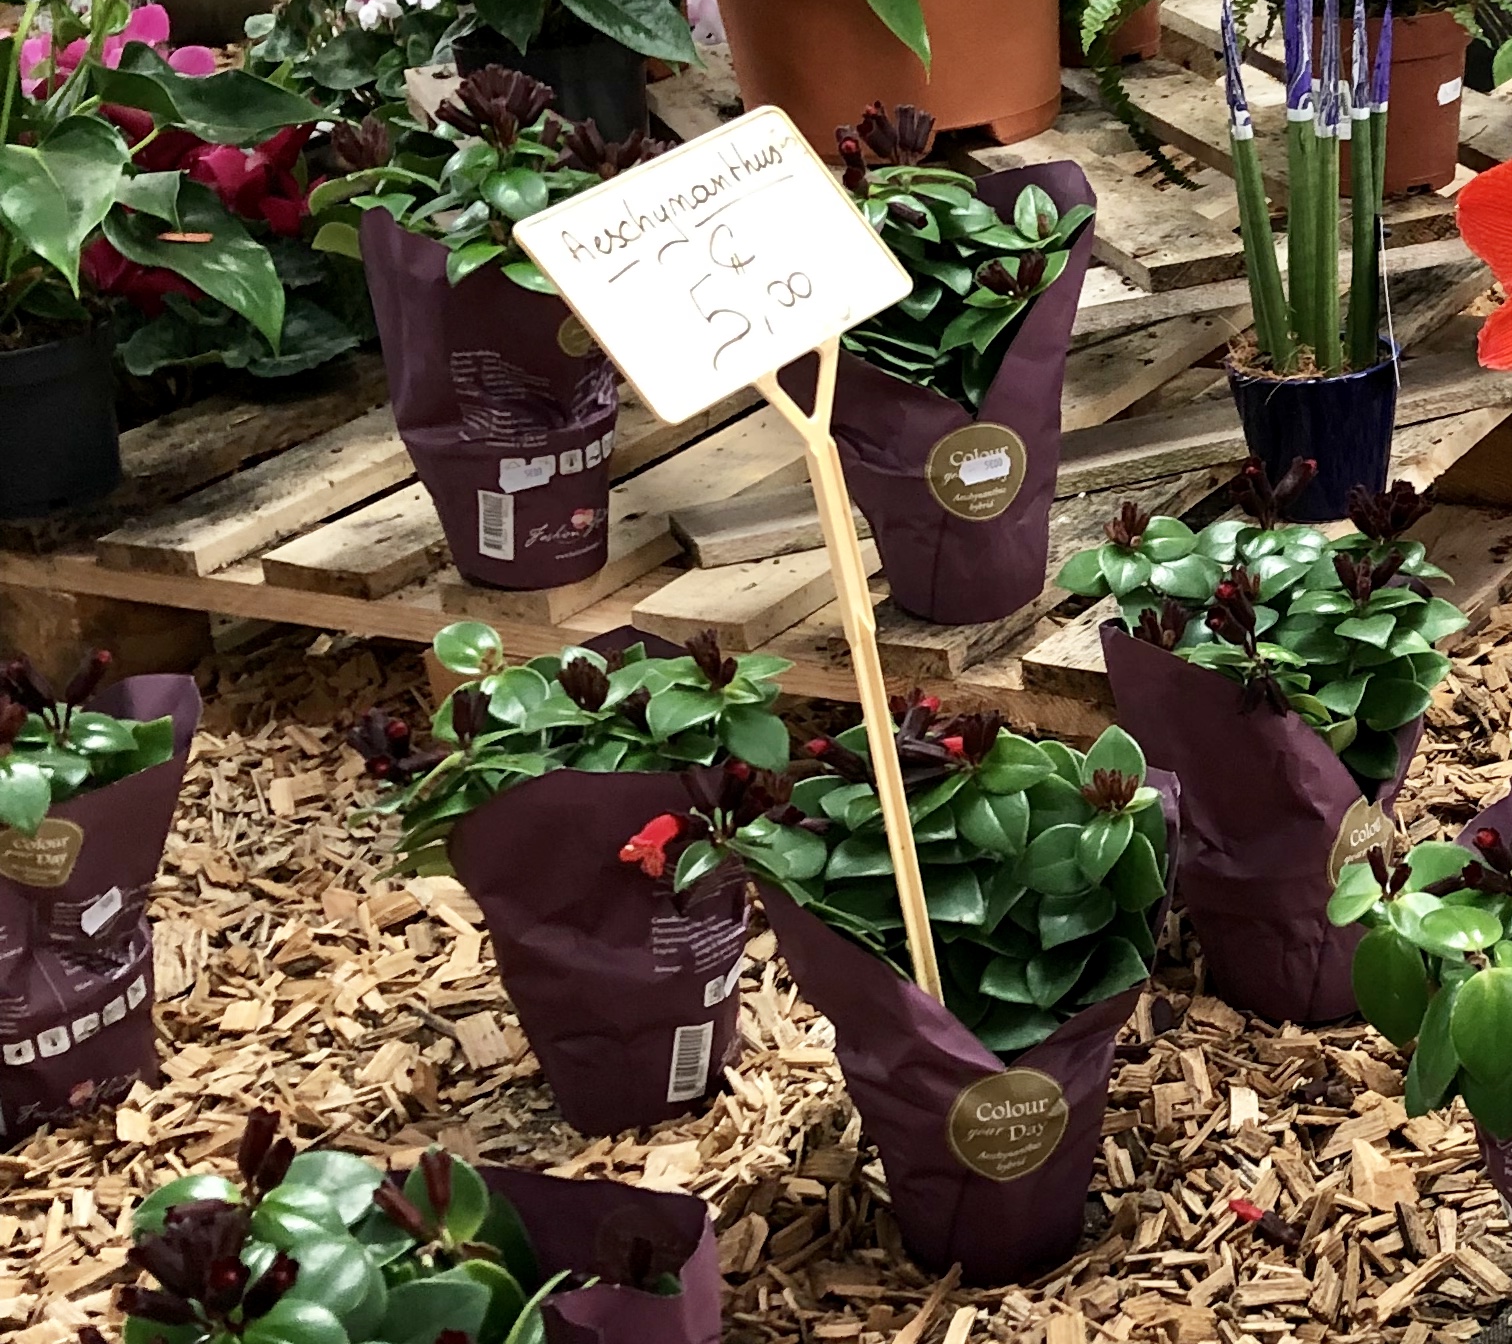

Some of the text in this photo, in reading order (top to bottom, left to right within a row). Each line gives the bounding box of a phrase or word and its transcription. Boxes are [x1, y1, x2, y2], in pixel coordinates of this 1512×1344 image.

[560, 142, 784, 263] Aeschynanthus
[689, 272, 813, 372] 5,00
[965, 1120, 1048, 1143] your Day
[975, 1097, 1050, 1123] Colour
